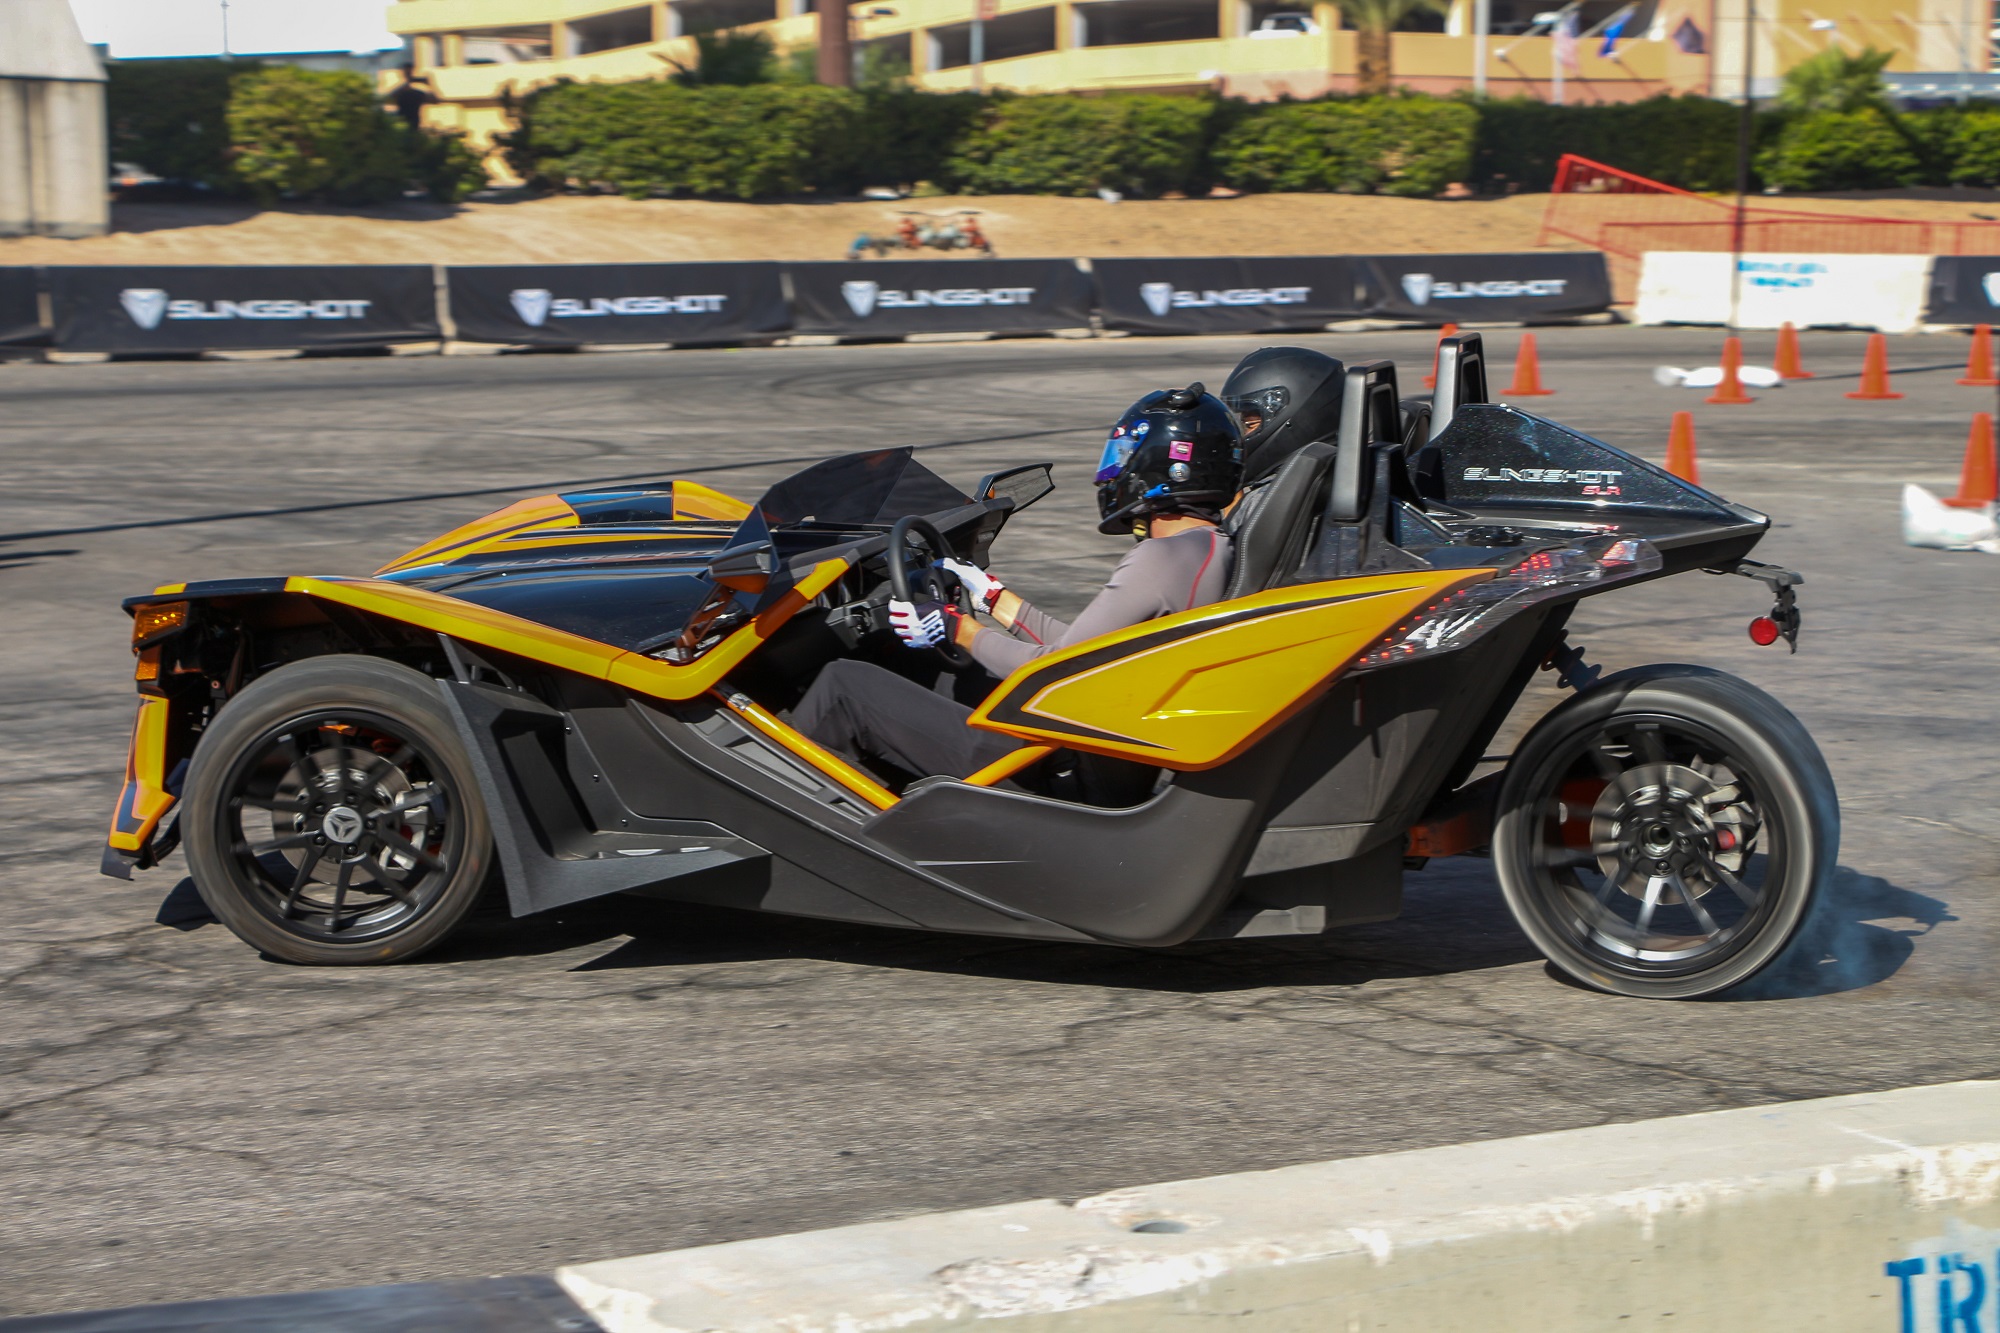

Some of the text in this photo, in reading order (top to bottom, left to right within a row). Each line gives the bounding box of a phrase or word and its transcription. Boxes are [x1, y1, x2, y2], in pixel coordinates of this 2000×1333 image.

[877, 287, 1036, 308] SLINGSHOT
[1171, 286, 1312, 308] SLINGSHOT
[1431, 279, 1569, 299] SLINGSHOT
[166, 299, 372, 321] SLINGSHOT
[550, 294, 728, 318] SLINGSHOT
[1463, 467, 1623, 484] SLINGSHOT
[1581, 485, 1621, 496] SLR
[476, 549, 723, 569] SLINGSHO
